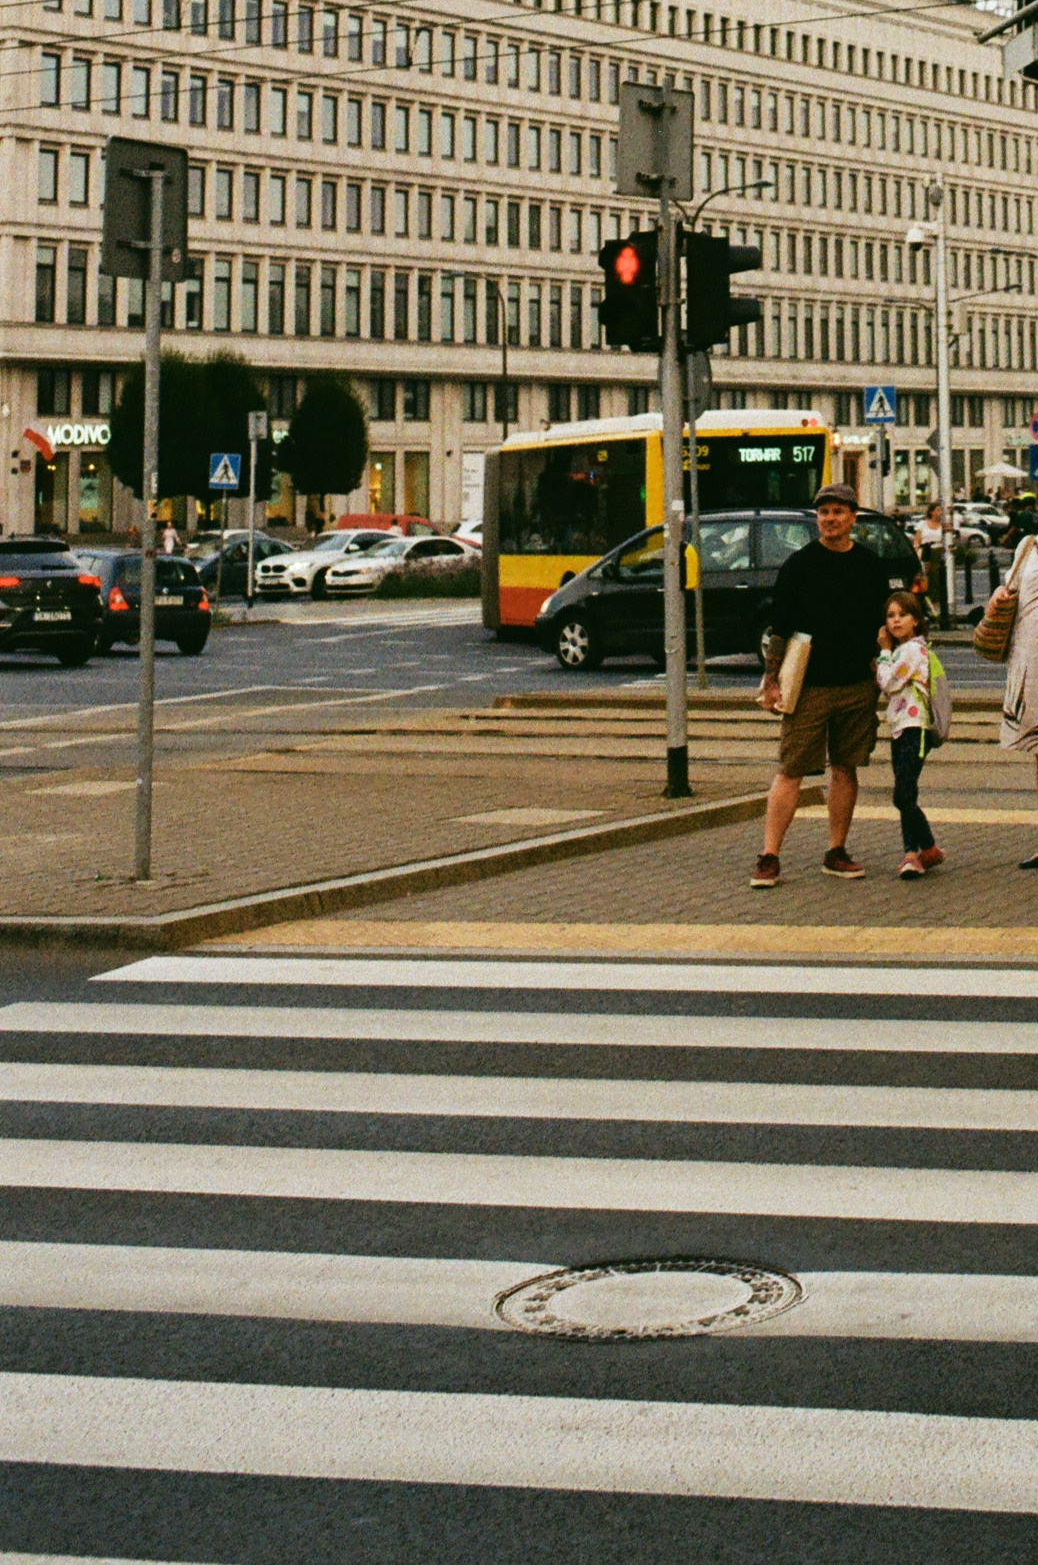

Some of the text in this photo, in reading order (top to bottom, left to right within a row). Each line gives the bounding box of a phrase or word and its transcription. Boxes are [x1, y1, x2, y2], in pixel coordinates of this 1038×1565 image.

[47, 424, 112, 445] MODIVO
[738, 445, 816, 463] TORWAR 517
